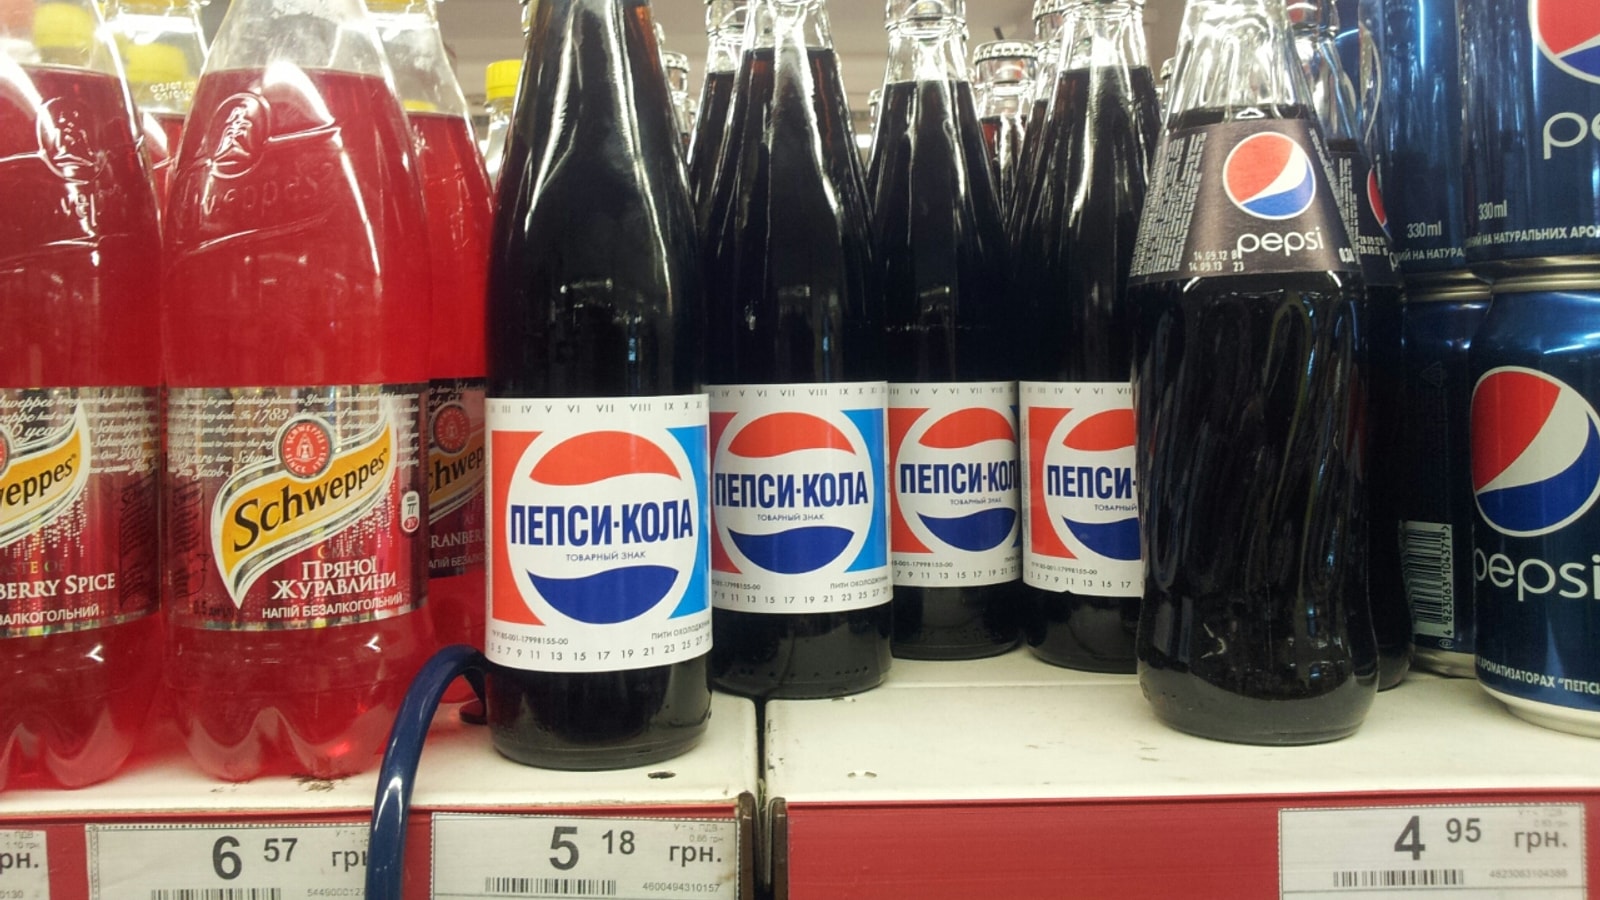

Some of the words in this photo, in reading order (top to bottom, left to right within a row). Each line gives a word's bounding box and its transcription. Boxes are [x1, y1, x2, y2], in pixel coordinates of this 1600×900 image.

[1407, 220, 1442, 238] 330ml
[1494, 227, 1568, 244] НАТУРАЛЬНИХ
[1236, 227, 1324, 258] pepsi
[757, 390, 768, 398] VI
[780, 389, 795, 397] VII
[808, 388, 828, 396] VIII
[521, 405, 532, 414] IV
[545, 405, 552, 414] V
[568, 405, 580, 414] VI
[596, 404, 614, 413] VII
[629, 404, 652, 412] VIII
[664, 402, 674, 411] IX
[429, 446, 485, 494] hwep
[1047, 464, 1136, 500] ПЕПСИ·
[233, 452, 387, 552] Schweppes
[950, 498, 986, 506] ТОВАРНЫЙ
[1094, 504, 1137, 512] ТОВАРНЫЙ
[757, 512, 800, 522] ТОВАРНЫЙ
[802, 513, 825, 521] ЗНАК
[566, 551, 619, 562] ТОВАРНЫЙ
[620, 550, 646, 560] ЗНАК
[302, 556, 378, 581] ПРЯНОЇ
[896, 570, 902, 578] 7
[988, 569, 996, 577] 19
[1474, 548, 1600, 602] pepsi
[271, 572, 397, 600] ЖУРАВЛИНИ
[262, 604, 300, 619] НАПІЙ
[302, 592, 403, 618] БЕЗАЛКОГОЛЬНИЙ
[746, 595, 756, 603] 13
[764, 596, 776, 604] 15
[784, 596, 796, 604] 17
[804, 596, 815, 604] 19
[842, 593, 852, 602] 23
[858, 592, 868, 600] 25
[652, 632, 672, 640] ПИТИ
[506, 646, 512, 655] 7
[516, 648, 522, 658] 9
[530, 650, 540, 659] 11
[550, 652, 562, 660] 13
[574, 652, 586, 661] 15
[598, 651, 610, 660] 17
[621, 649, 634, 658] 19
[643, 646, 655, 656] 21
[664, 644, 675, 654] 23
[682, 640, 692, 650] 25
[1480, 659, 1556, 688] АРОМАТИЗАТОРАХ
[549, 826, 580, 870] 5
[601, 830, 636, 856] 18
[1394, 815, 1426, 861] 4
[1446, 818, 1482, 843] 95
[1514, 830, 1568, 854] грн.
[0, 852, 39, 875] рн.
[212, 834, 242, 881] 6
[263, 837, 298, 863] 57
[669, 845, 722, 868] грн.
[642, 882, 720, 892] 4600494310157
